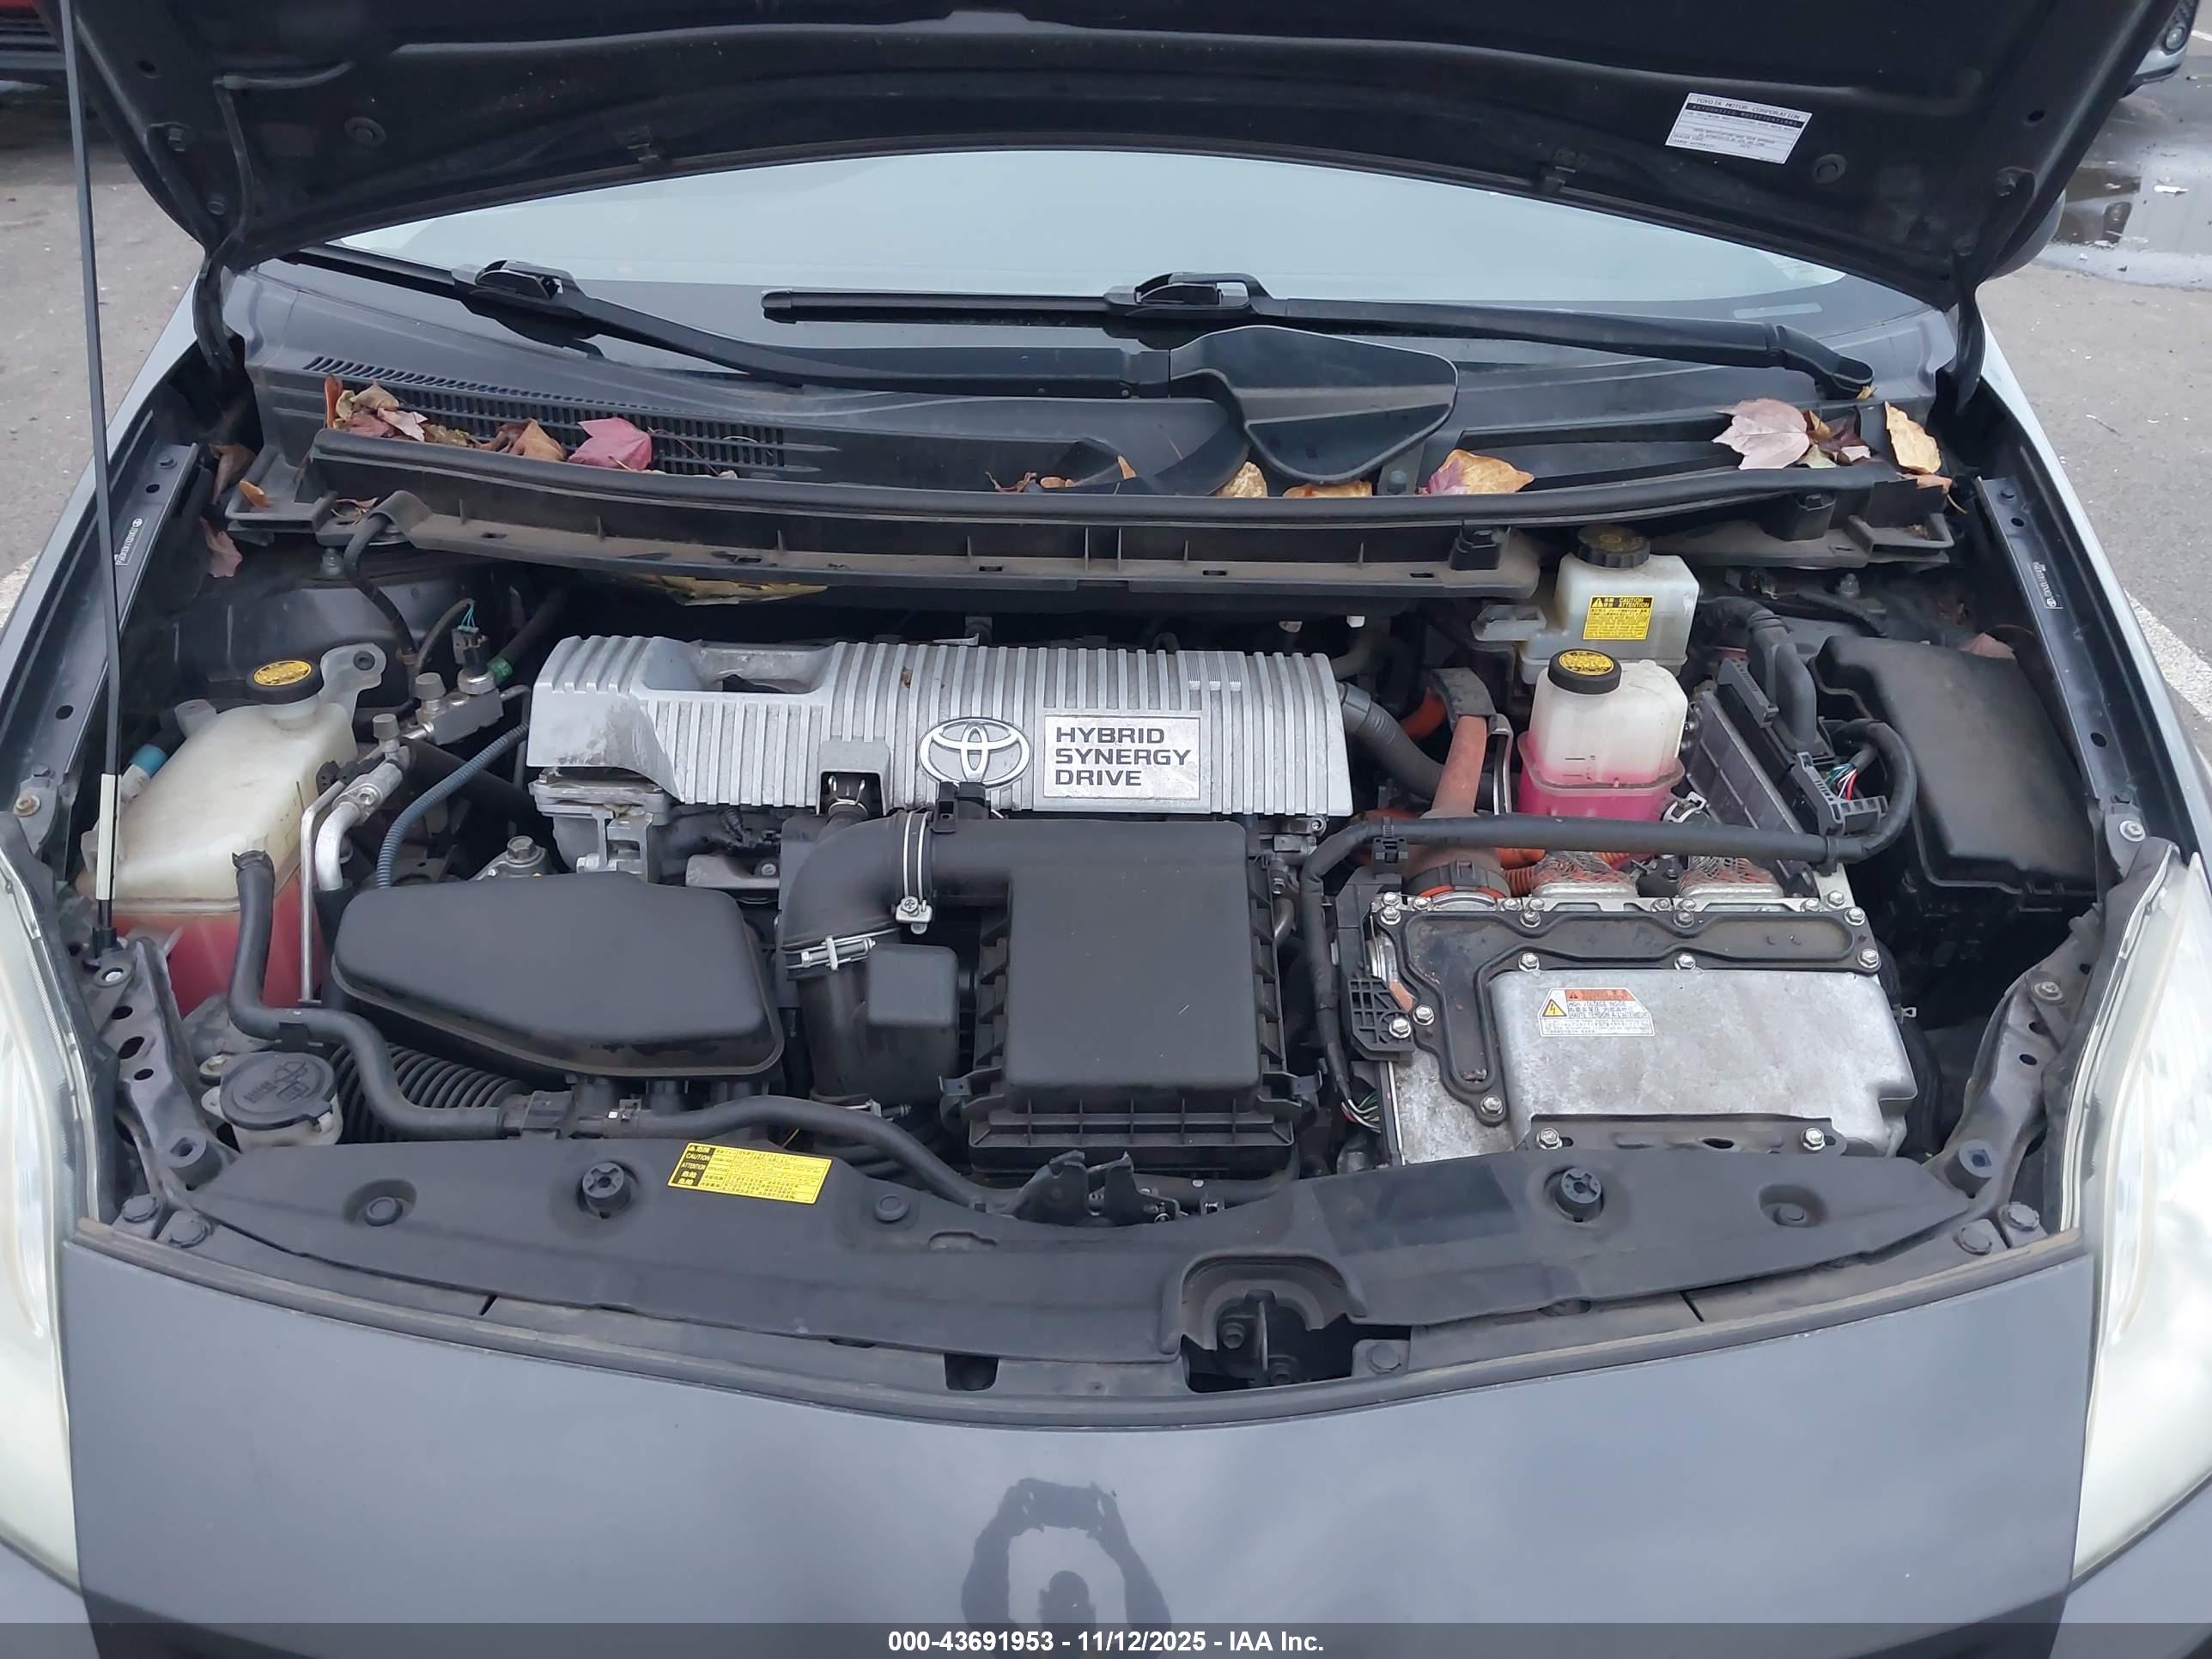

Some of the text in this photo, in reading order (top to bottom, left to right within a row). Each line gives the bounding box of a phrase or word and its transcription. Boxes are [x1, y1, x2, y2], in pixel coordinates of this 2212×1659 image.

[1696, 98, 1801, 120] TOYOTA MOTOR CORPORATION
[1055, 726, 1165, 744] HYBRID
[1054, 748, 1192, 765] SYNERGY
[1054, 769, 1143, 787] DRIVE
[681, 1161, 708, 1170] ATTENTION
[685, 1152, 712, 1162] CAUTION
